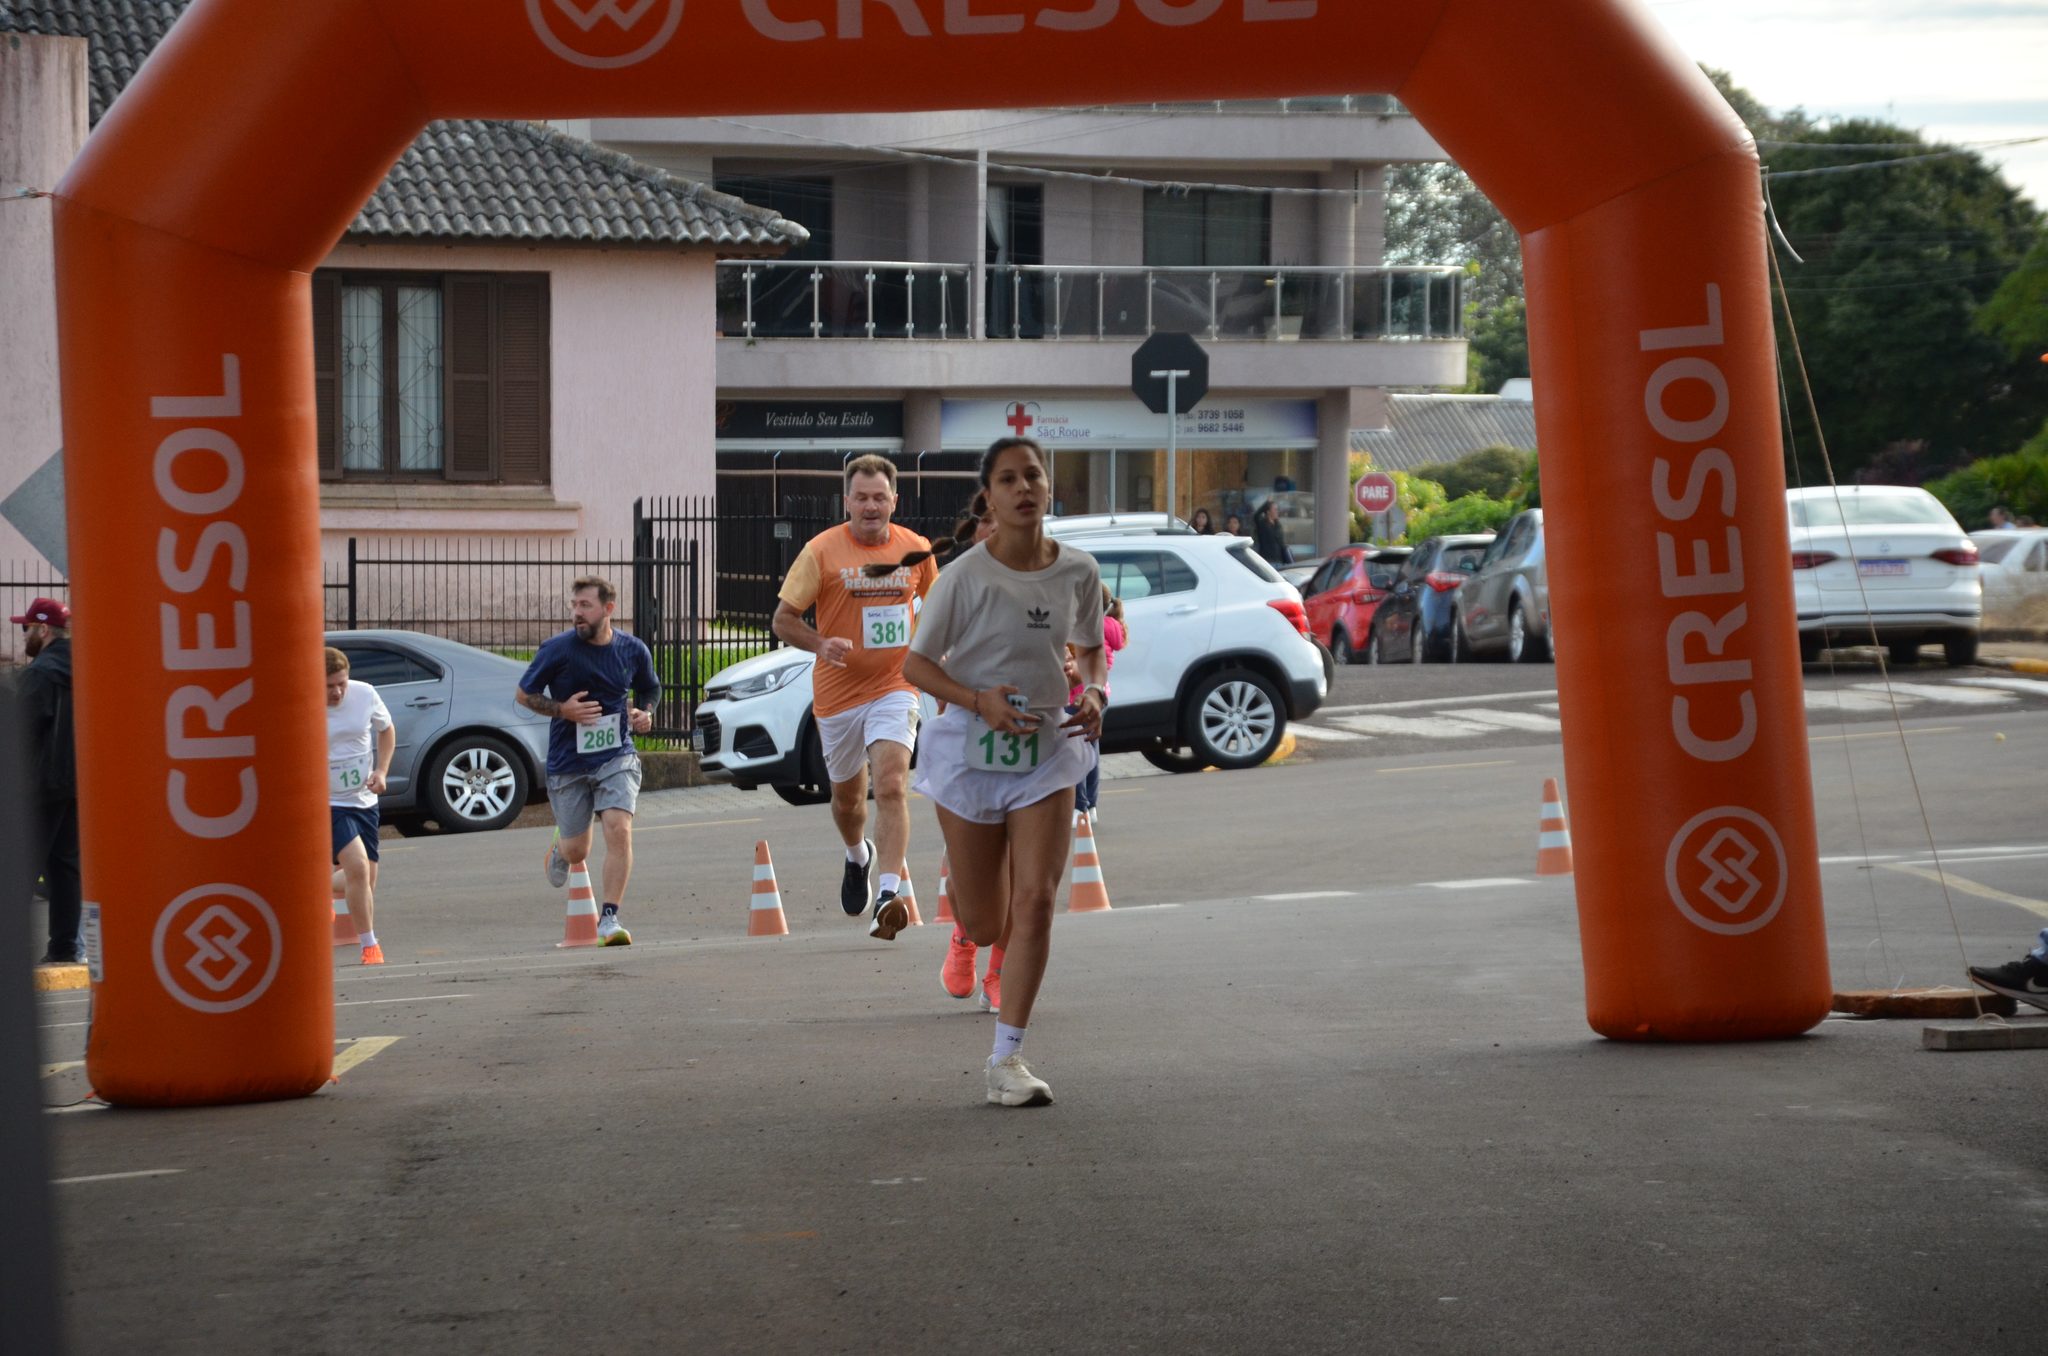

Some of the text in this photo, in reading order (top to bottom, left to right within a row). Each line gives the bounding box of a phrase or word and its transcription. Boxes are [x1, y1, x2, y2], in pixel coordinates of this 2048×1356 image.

[765, 411, 874, 427] Vestindo Seu Estilo
[1059, 426, 1091, 438] Roque
[1362, 485, 1389, 499] PARE
[1640, 283, 1758, 762] CRESOL
[844, 577, 911, 589] REGIONAL
[150, 353, 259, 839] CRESOL
[871, 620, 905, 645] 381
[584, 727, 615, 749] 286
[979, 730, 1039, 767] 131
[340, 769, 361, 788] 13
